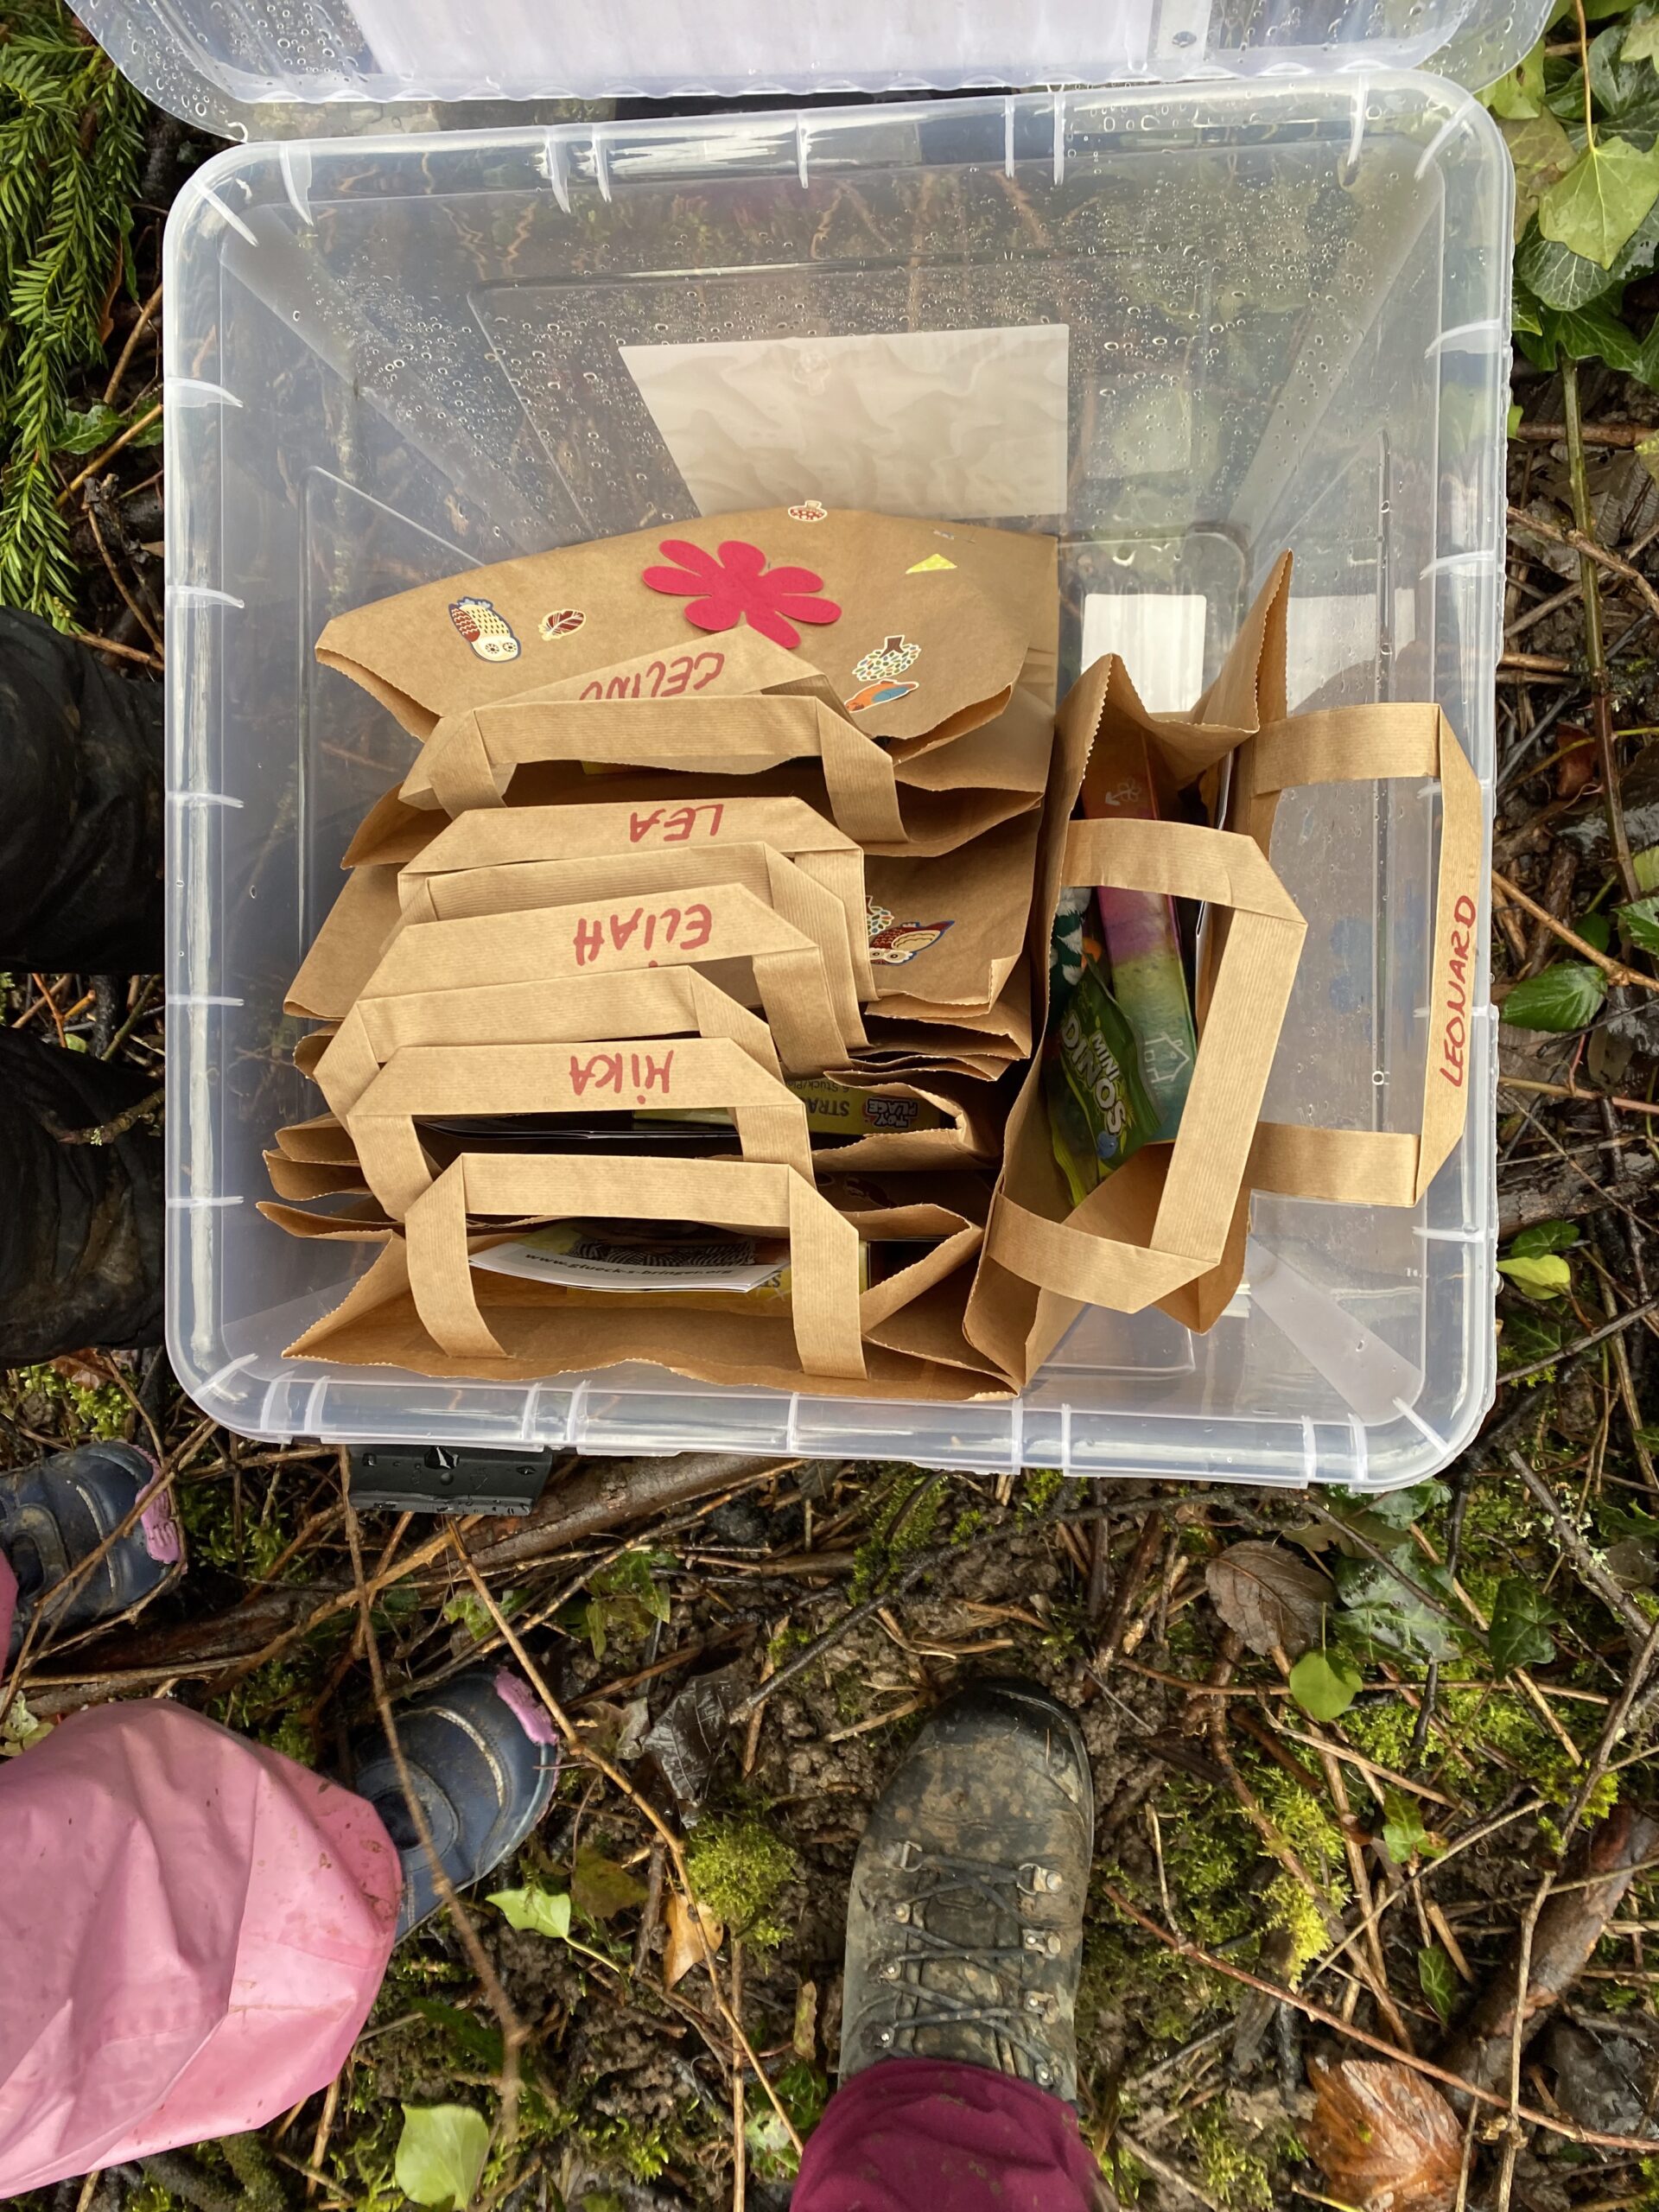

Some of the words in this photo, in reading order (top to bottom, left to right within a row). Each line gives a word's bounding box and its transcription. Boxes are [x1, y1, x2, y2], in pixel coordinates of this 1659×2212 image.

[628, 800, 726, 844] LEA
[1440, 895, 1477, 1088] LEONARD
[1061, 1014, 1127, 1135] DINOS
[1090, 1031, 1121, 1082] MINI
[865, 1098, 918, 1117] PLACE
[873, 1115, 909, 1128] TOY
